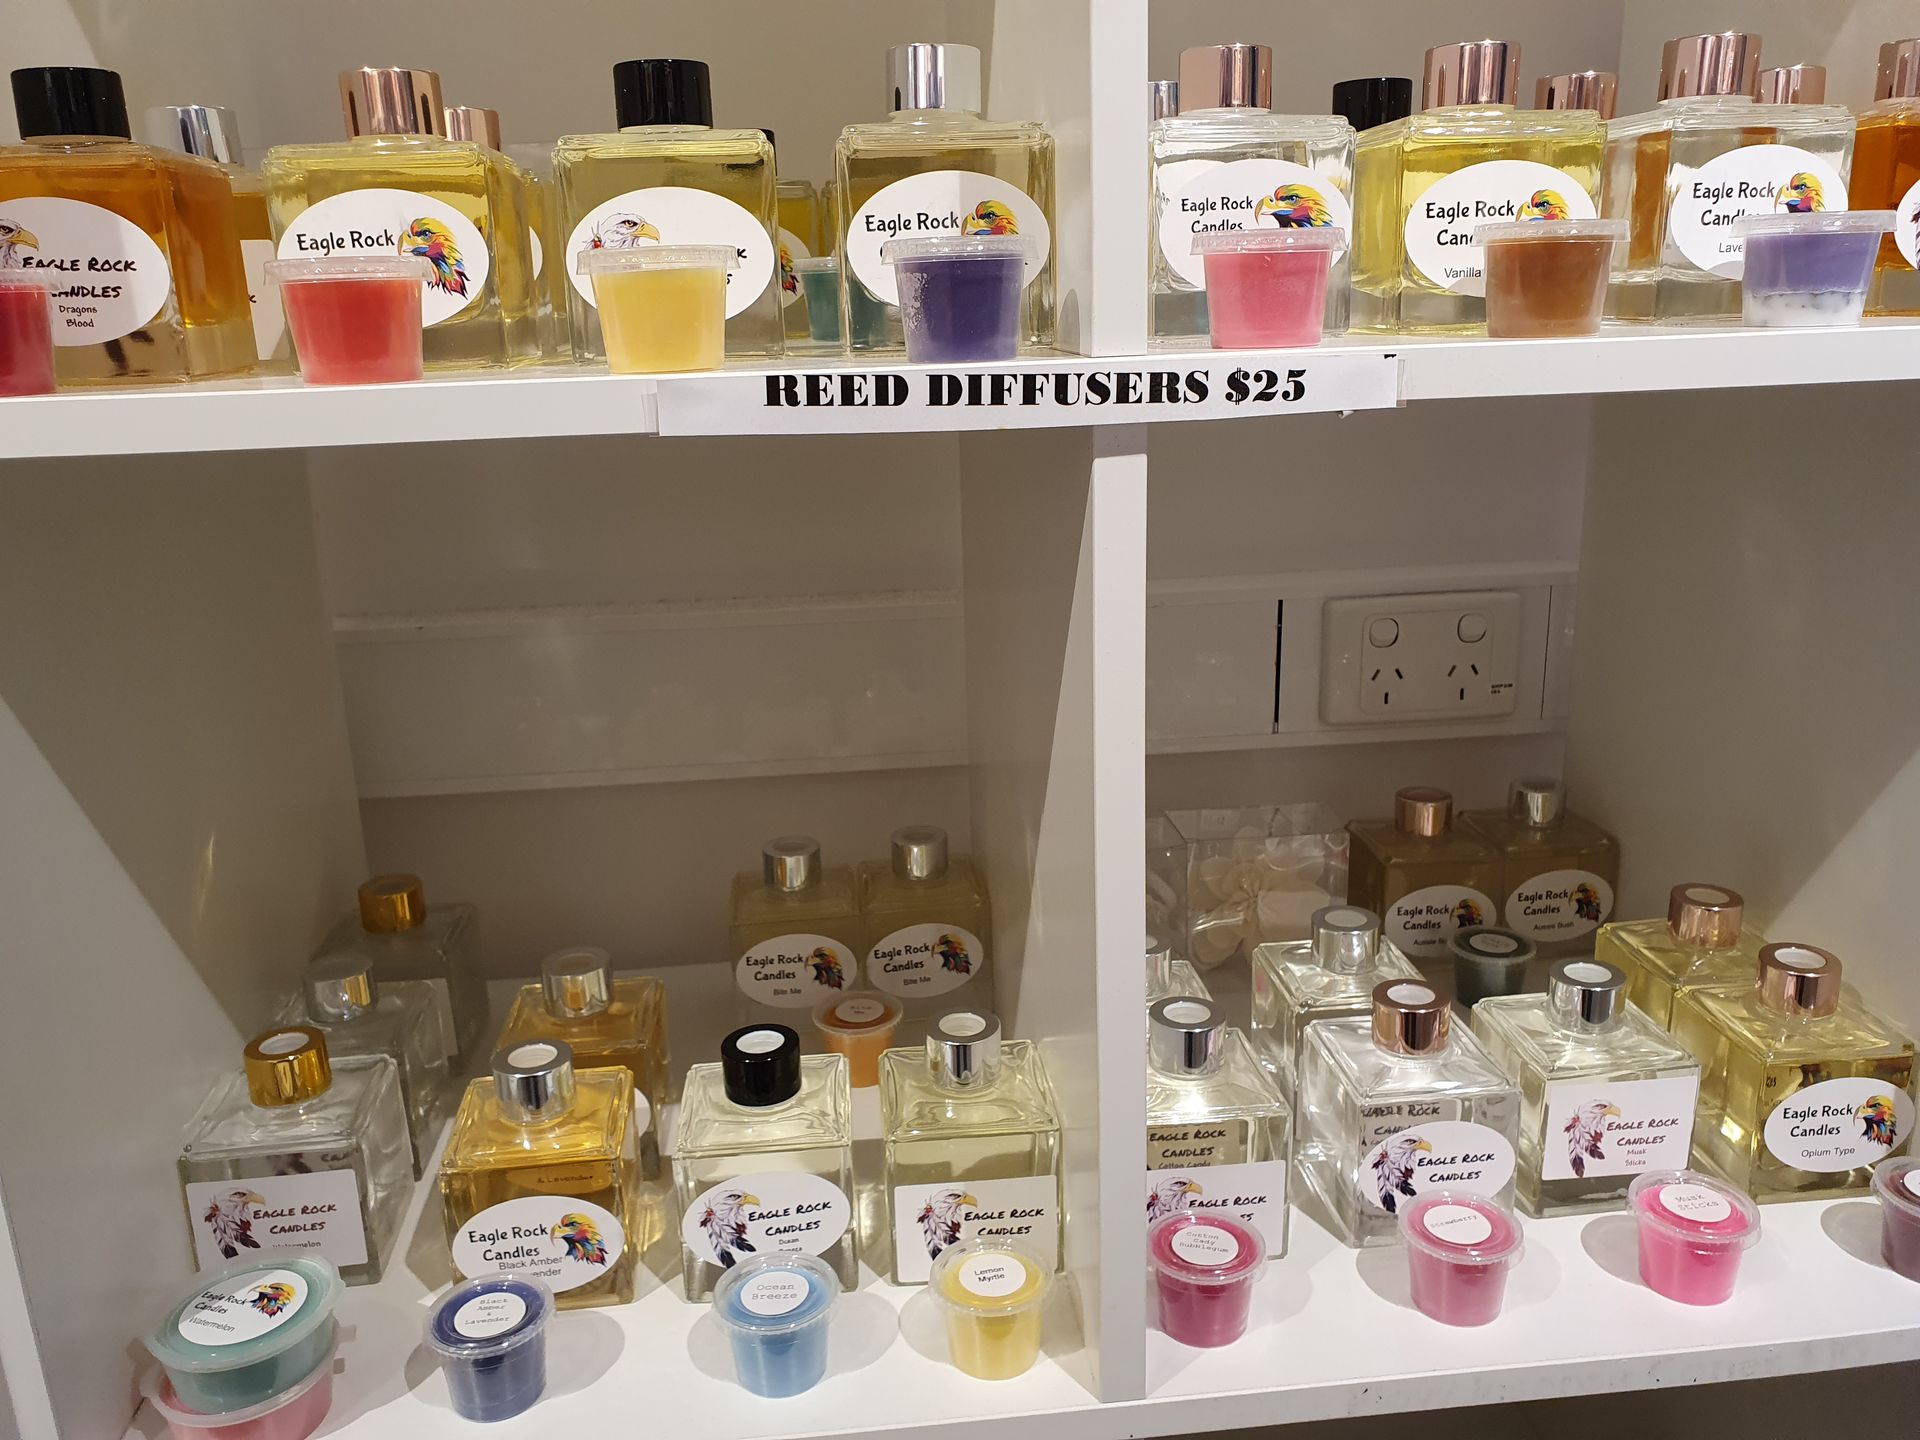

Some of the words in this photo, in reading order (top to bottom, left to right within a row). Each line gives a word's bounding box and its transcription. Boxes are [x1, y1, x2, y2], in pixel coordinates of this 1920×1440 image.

[1693, 181, 1734, 204] Eagle
[1738, 181, 1775, 199] Rock
[1181, 197, 1217, 216] Eagle
[1221, 195, 1253, 211] Rock
[1426, 202, 1470, 224] Eagle
[1475, 200, 1515, 218] Rock
[865, 214, 912, 237] Eagle
[917, 211, 959, 231] Rock
[1191, 219, 1243, 234] Candles
[296, 233, 345, 256] Eagle
[350, 229, 395, 249] Rock
[88, 256, 137, 272] ROCK
[1444, 267, 1481, 278] Vanilla
[58, 304, 98, 317] Dragons
[66, 318, 95, 328] Blood
[763, 374, 909, 407] REED
[926, 369, 1211, 407] DIFFUSERS
[1225, 367, 1307, 406] $25
[1517, 891, 1543, 904] Eagle
[1545, 889, 1569, 900] Rock
[1397, 906, 1423, 919] Eagle
[1425, 904, 1449, 915] Rock
[1523, 905, 1561, 916] Candles
[1403, 919, 1441, 930] Candles
[874, 948, 902, 961] Eagle
[905, 943, 931, 954] Rock
[746, 956, 775, 968] Eagle
[777, 954, 804, 965] Rock
[883, 961, 924, 973] Candles
[754, 970, 797, 982] Candles
[1783, 1106, 1818, 1122] Eagle
[1822, 1104, 1853, 1117] Rock
[1607, 1121, 1644, 1132] EAGLE
[1648, 1117, 1679, 1128] ROCK
[1790, 1124, 1841, 1137] Candles
[1149, 1131, 1189, 1142] EAGLE
[1194, 1129, 1226, 1140] ROCK
[1617, 1135, 1666, 1147] CANDLES
[1162, 1147, 1215, 1158] CANDLES
[1801, 1148, 1831, 1158] Opium
[1834, 1146, 1856, 1157] Type
[1418, 1156, 1457, 1167] EAGLE
[1462, 1153, 1495, 1164] ROCK
[1429, 1171, 1482, 1183] CANDLES
[1189, 1198, 1228, 1208] EAGLE
[1233, 1196, 1267, 1206] ROCK
[253, 1207, 295, 1219] EAGLE
[301, 1203, 337, 1215] ROCK
[748, 1208, 790, 1222] EAGLE
[796, 1201, 832, 1215] ROCK
[964, 1211, 1005, 1222] EAGLE
[1010, 1208, 1044, 1219] ROCK
[270, 1221, 326, 1235] CANDLES
[468, 1228, 508, 1246] Eagle
[512, 1224, 548, 1238] Rock
[765, 1220, 821, 1237] CANDLES
[978, 1225, 1032, 1237] CANDLES
[483, 1245, 540, 1261] Candles
[499, 1260, 526, 1270] Black
[530, 1255, 563, 1267] Amber
[974, 1266, 1004, 1276] Lemon
[978, 1273, 1005, 1283] Myrtle
[201, 1291, 225, 1304] Eagle
[225, 1294, 248, 1306] Rock
[194, 1301, 229, 1315] Candles
[188, 1316, 236, 1333] Watermelon
